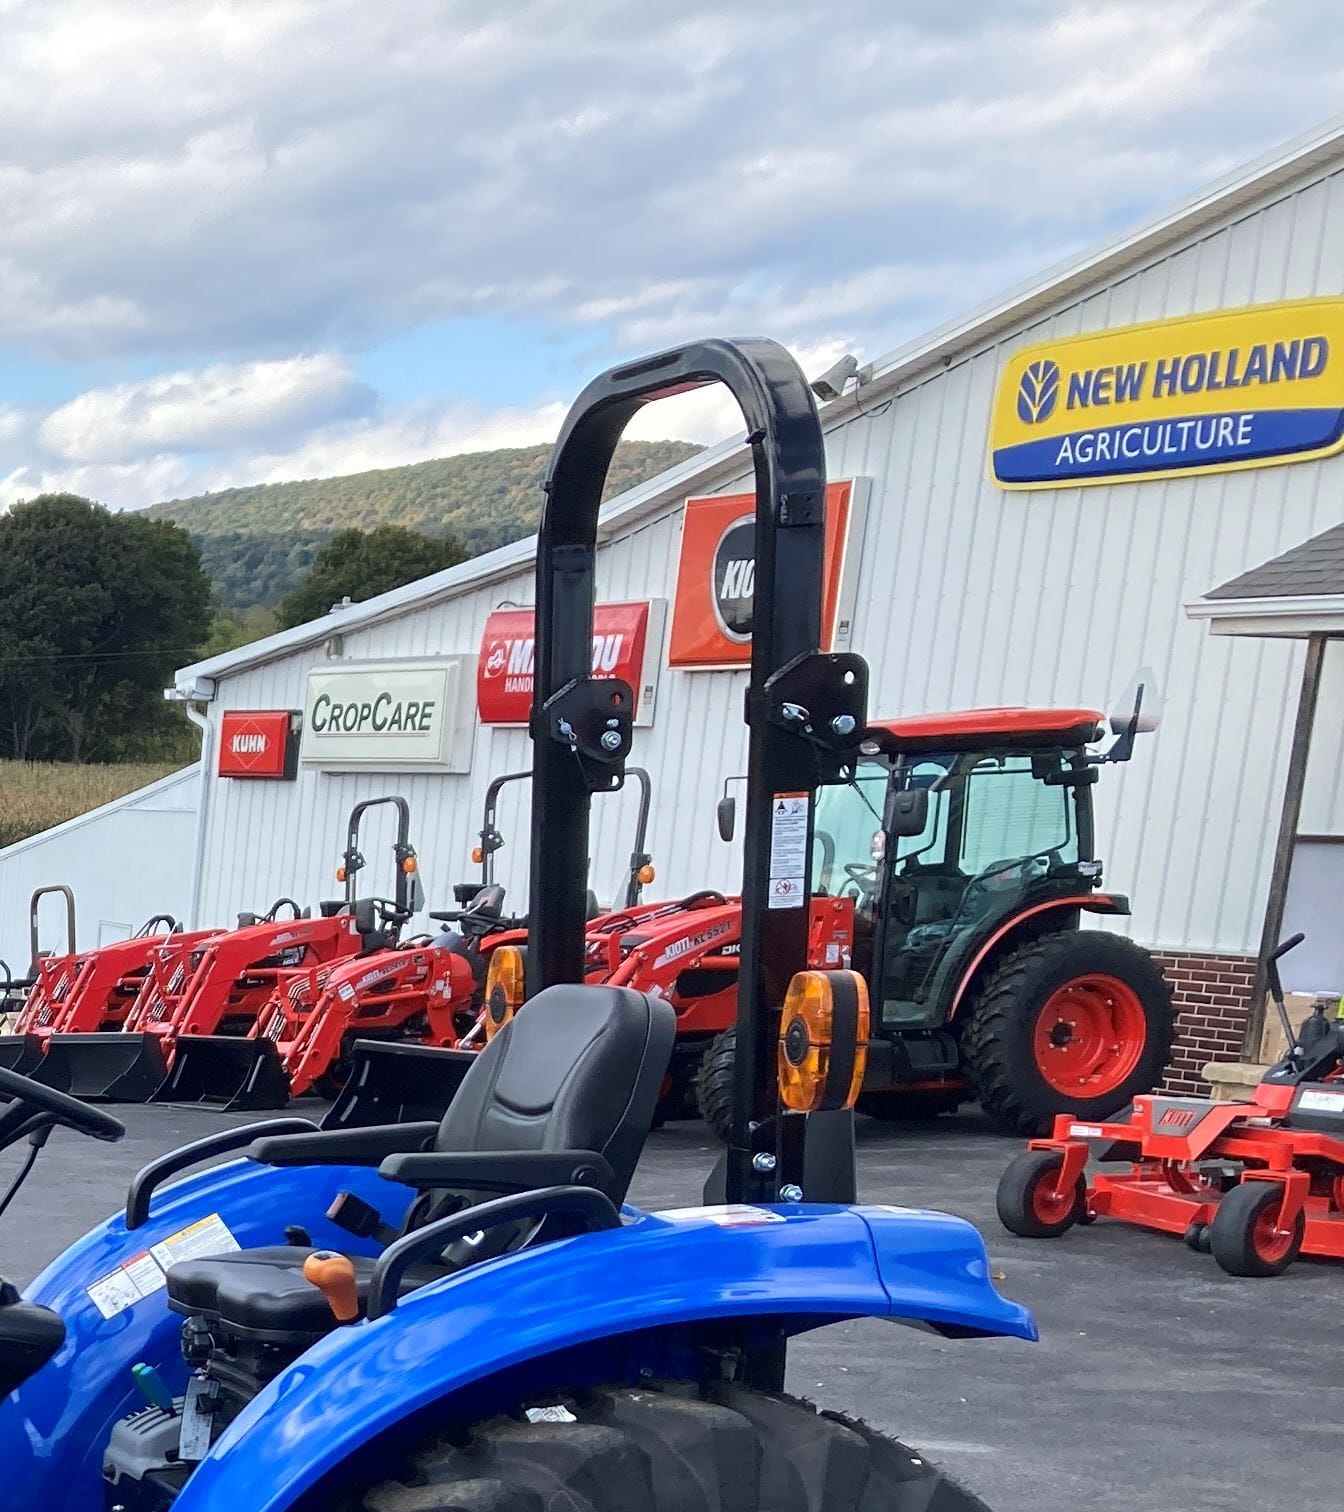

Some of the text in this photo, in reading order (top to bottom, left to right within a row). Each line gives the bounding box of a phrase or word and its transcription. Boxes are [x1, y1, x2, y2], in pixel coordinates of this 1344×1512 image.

[1066, 335, 1330, 410] NEW HOLLAND
[1055, 414, 1254, 466] AGRICULTURE
[232, 734, 266, 753] KUHN
